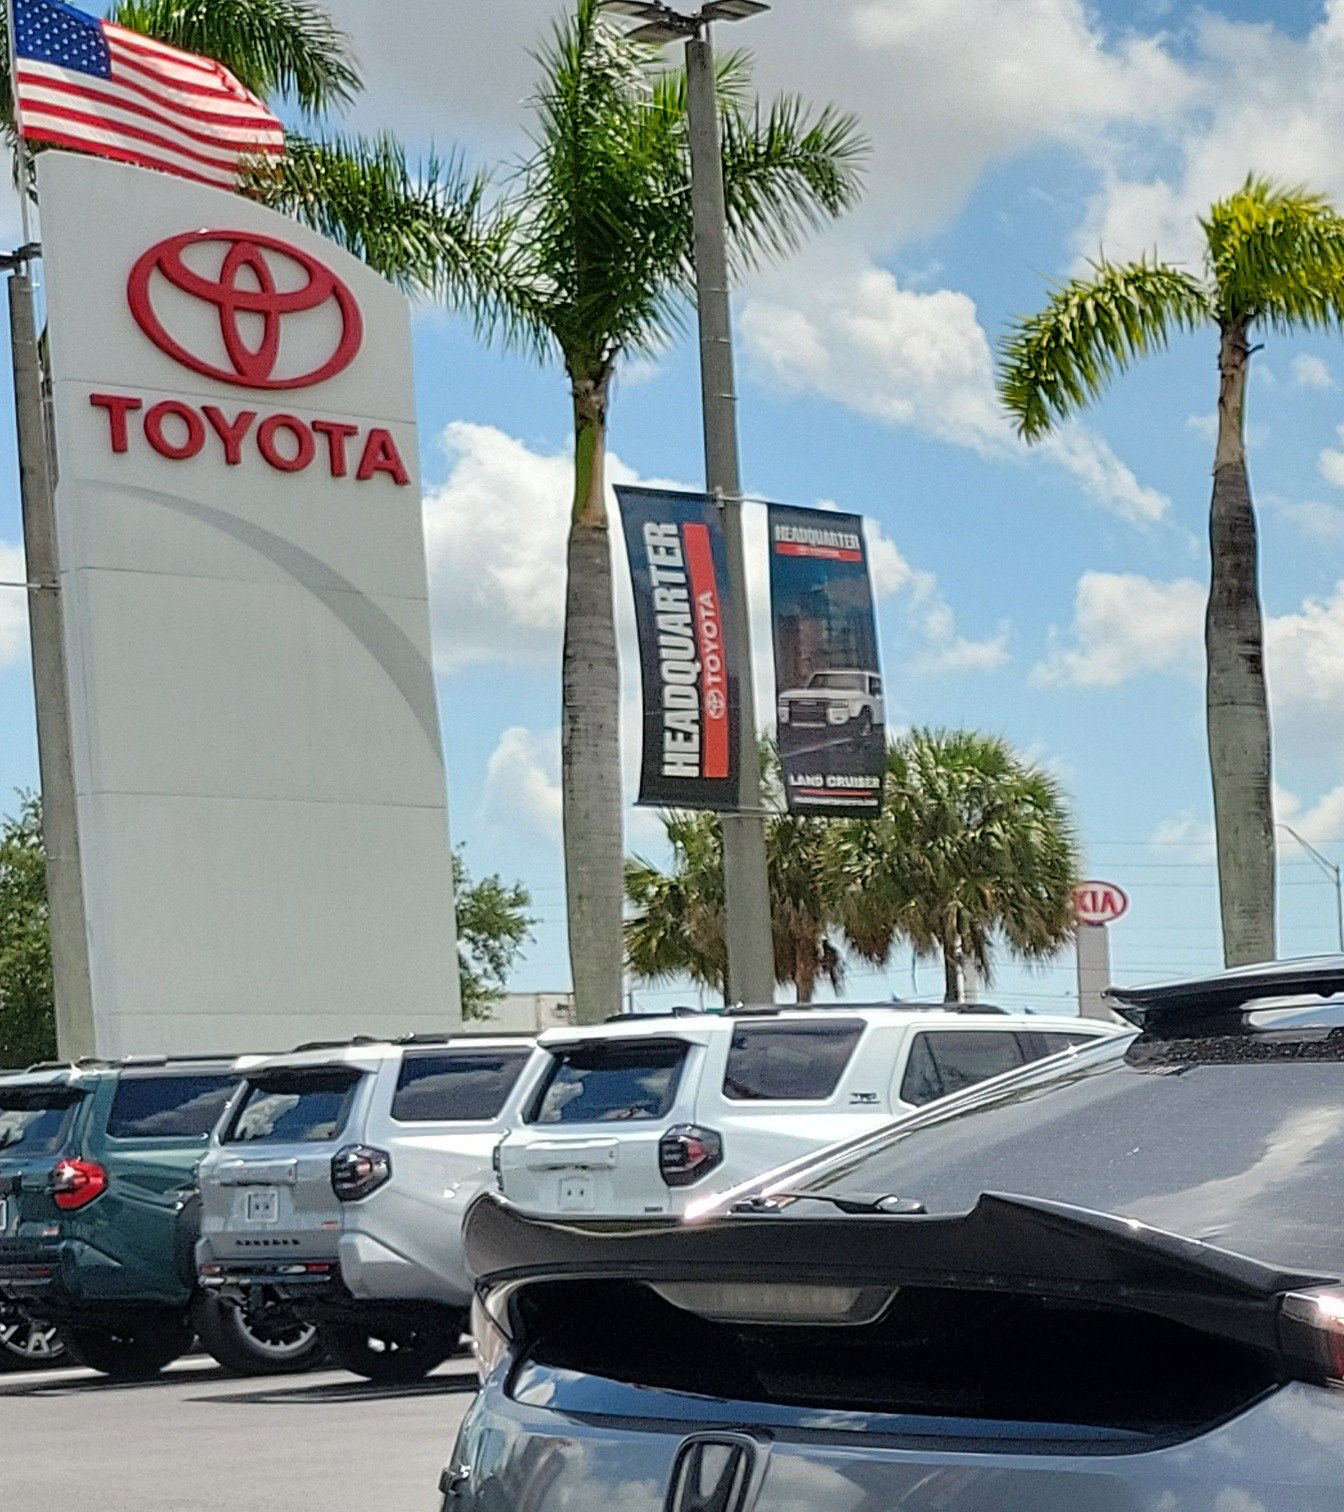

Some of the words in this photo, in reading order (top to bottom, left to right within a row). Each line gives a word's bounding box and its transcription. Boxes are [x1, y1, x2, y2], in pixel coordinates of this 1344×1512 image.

[90, 393, 412, 486] TOYOTA
[643, 520, 701, 778] HEADQUARTER
[698, 590, 722, 685] TOYOTA
[789, 773, 824, 787] LAND
[825, 775, 880, 788] CRUISER
